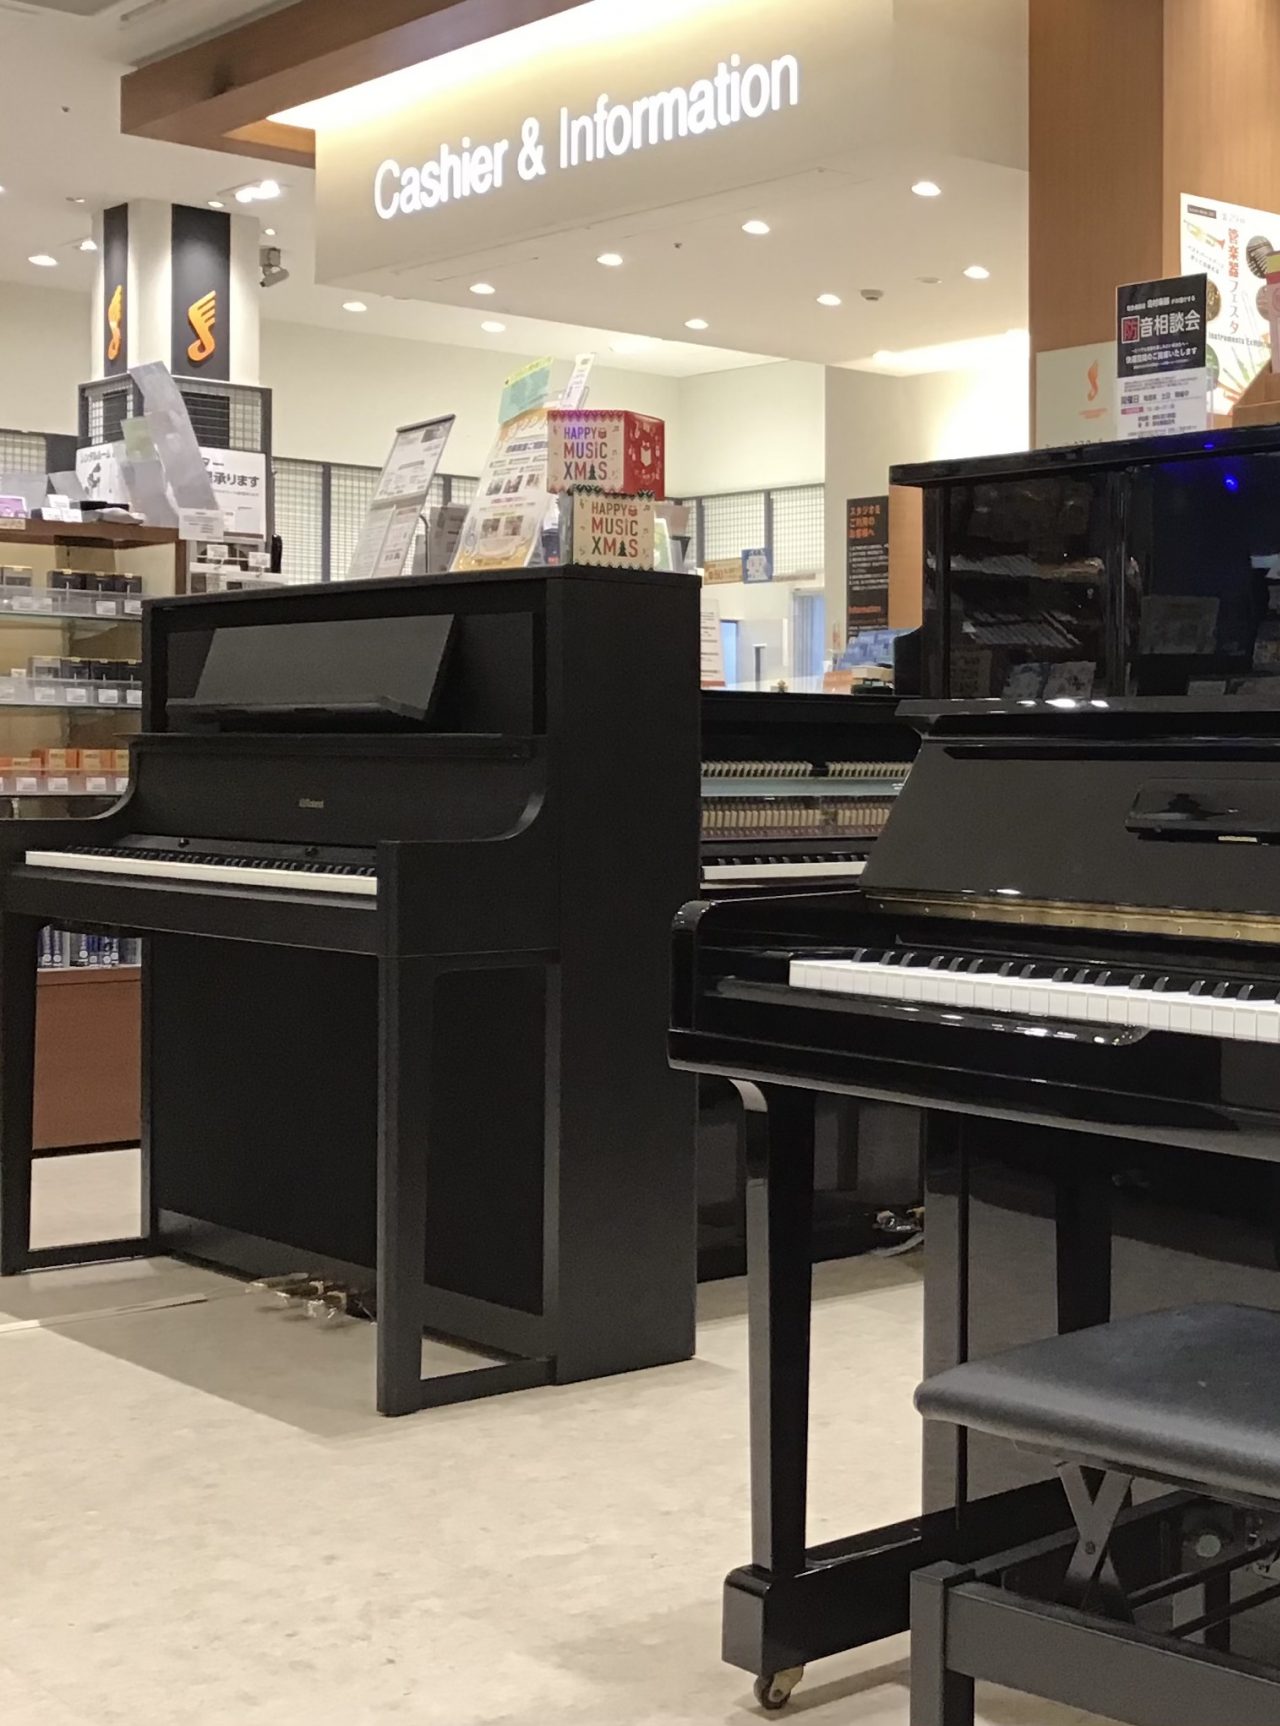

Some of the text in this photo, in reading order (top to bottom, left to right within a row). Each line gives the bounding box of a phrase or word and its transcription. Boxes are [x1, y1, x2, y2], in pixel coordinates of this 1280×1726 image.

[374, 53, 798, 219] Cashier & Information
[1122, 309, 1201, 343] 防音相談会
[564, 427, 597, 440] HAPPY
[592, 502, 628, 515] HAPPY
